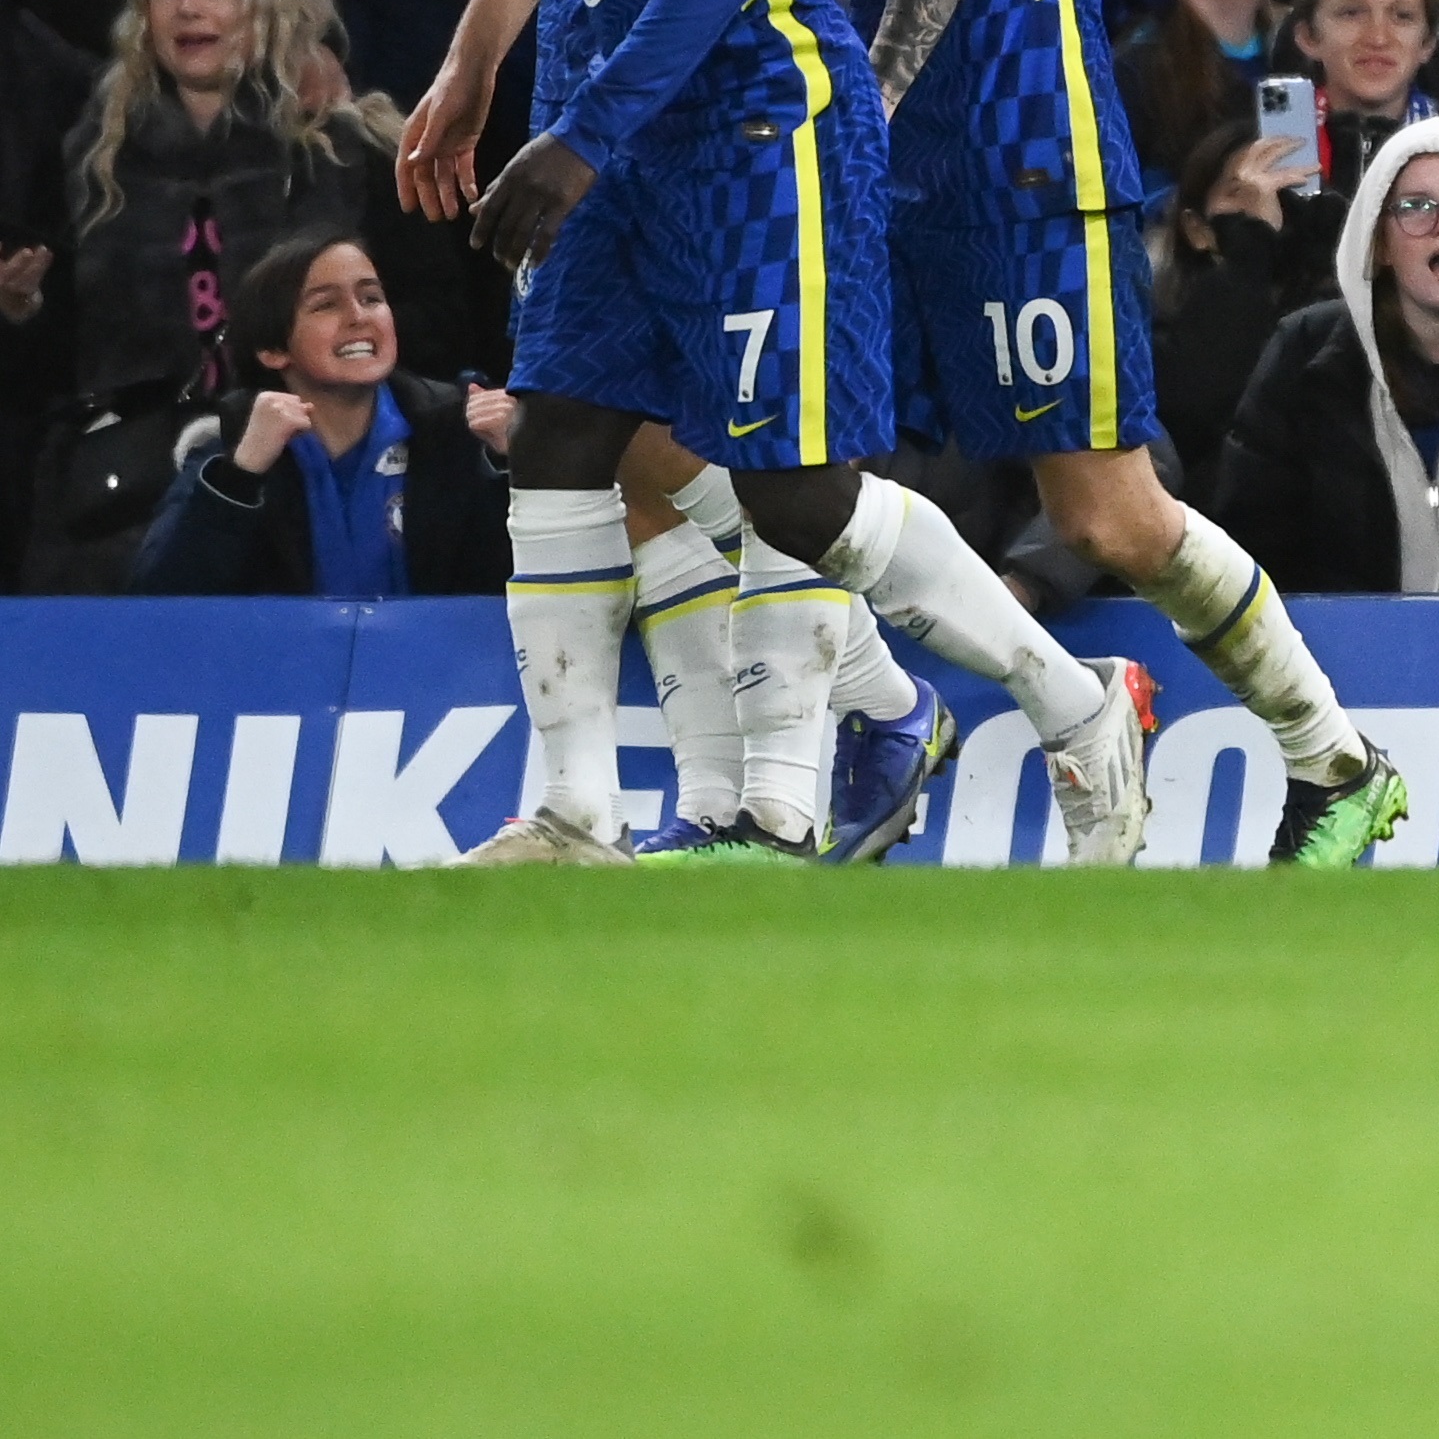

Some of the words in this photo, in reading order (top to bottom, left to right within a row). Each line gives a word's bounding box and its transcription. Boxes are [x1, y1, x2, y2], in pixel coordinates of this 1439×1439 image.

[723, 309, 775, 403] 7
[984, 297, 1074, 386] 10
[733, 661, 767, 684] FC
